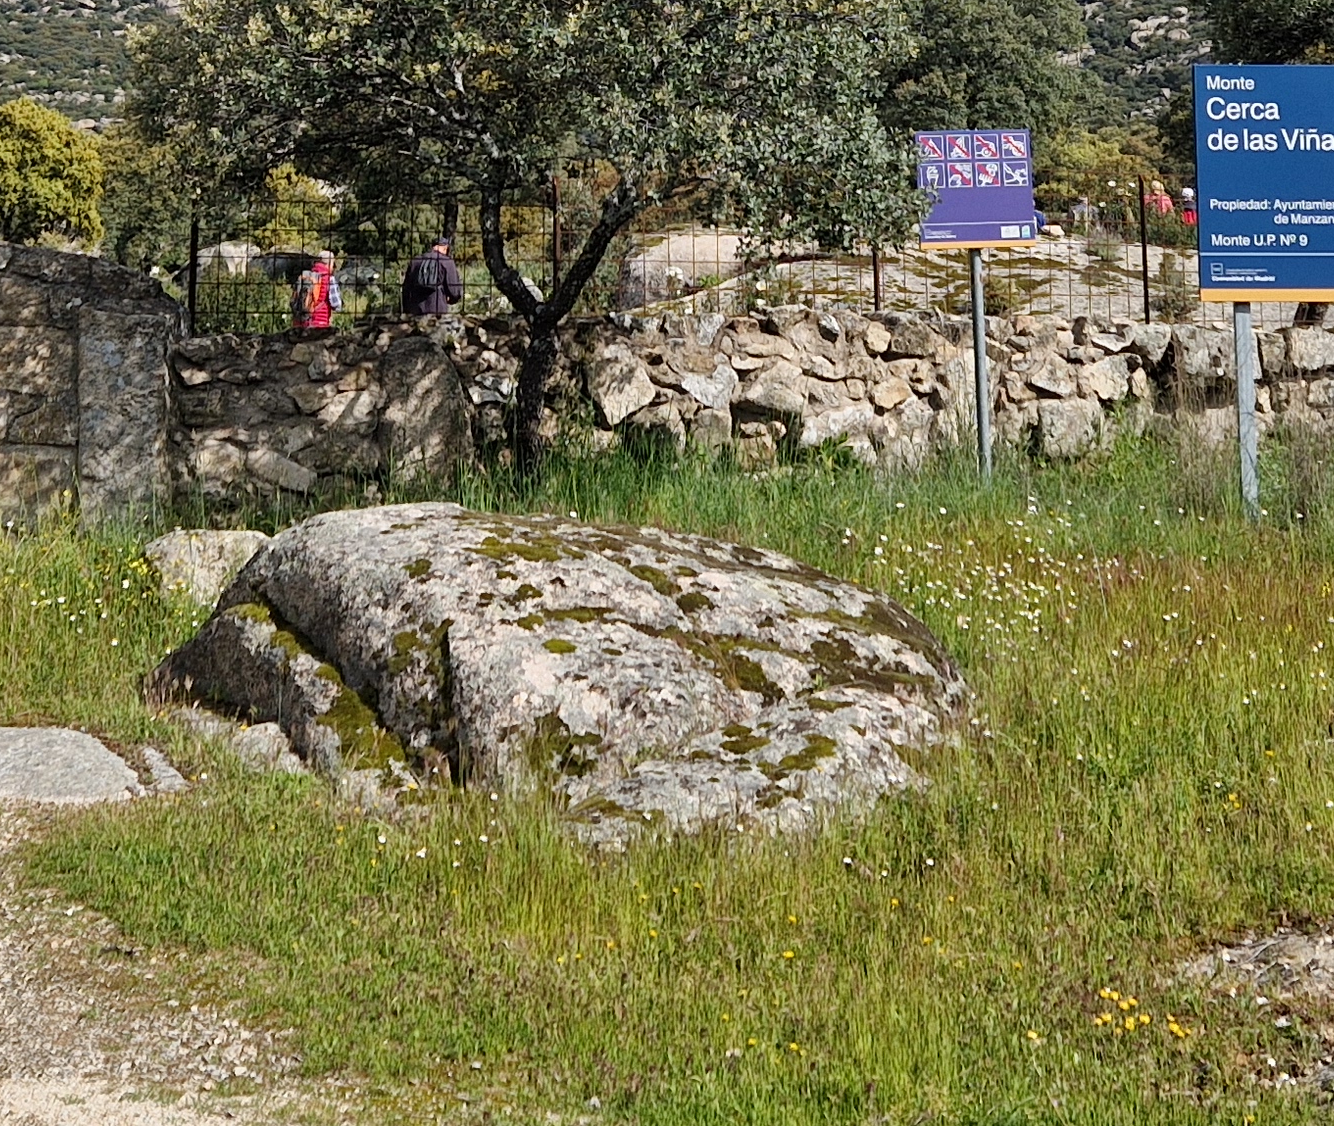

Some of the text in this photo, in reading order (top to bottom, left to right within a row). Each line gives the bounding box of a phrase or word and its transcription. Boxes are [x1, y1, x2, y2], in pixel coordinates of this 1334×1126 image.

[1205, 75, 1255, 91] Monte
[1206, 96, 1280, 121] Cerca
[1207, 128, 1239, 151] de
[1243, 128, 1279, 151] las
[1209, 198, 1272, 213] Propiedad:
[1273, 213, 1289, 225] de
[1211, 233, 1251, 247] Monte
[1254, 233, 1277, 247] U.P.
[1298, 233, 1308, 247] 9
